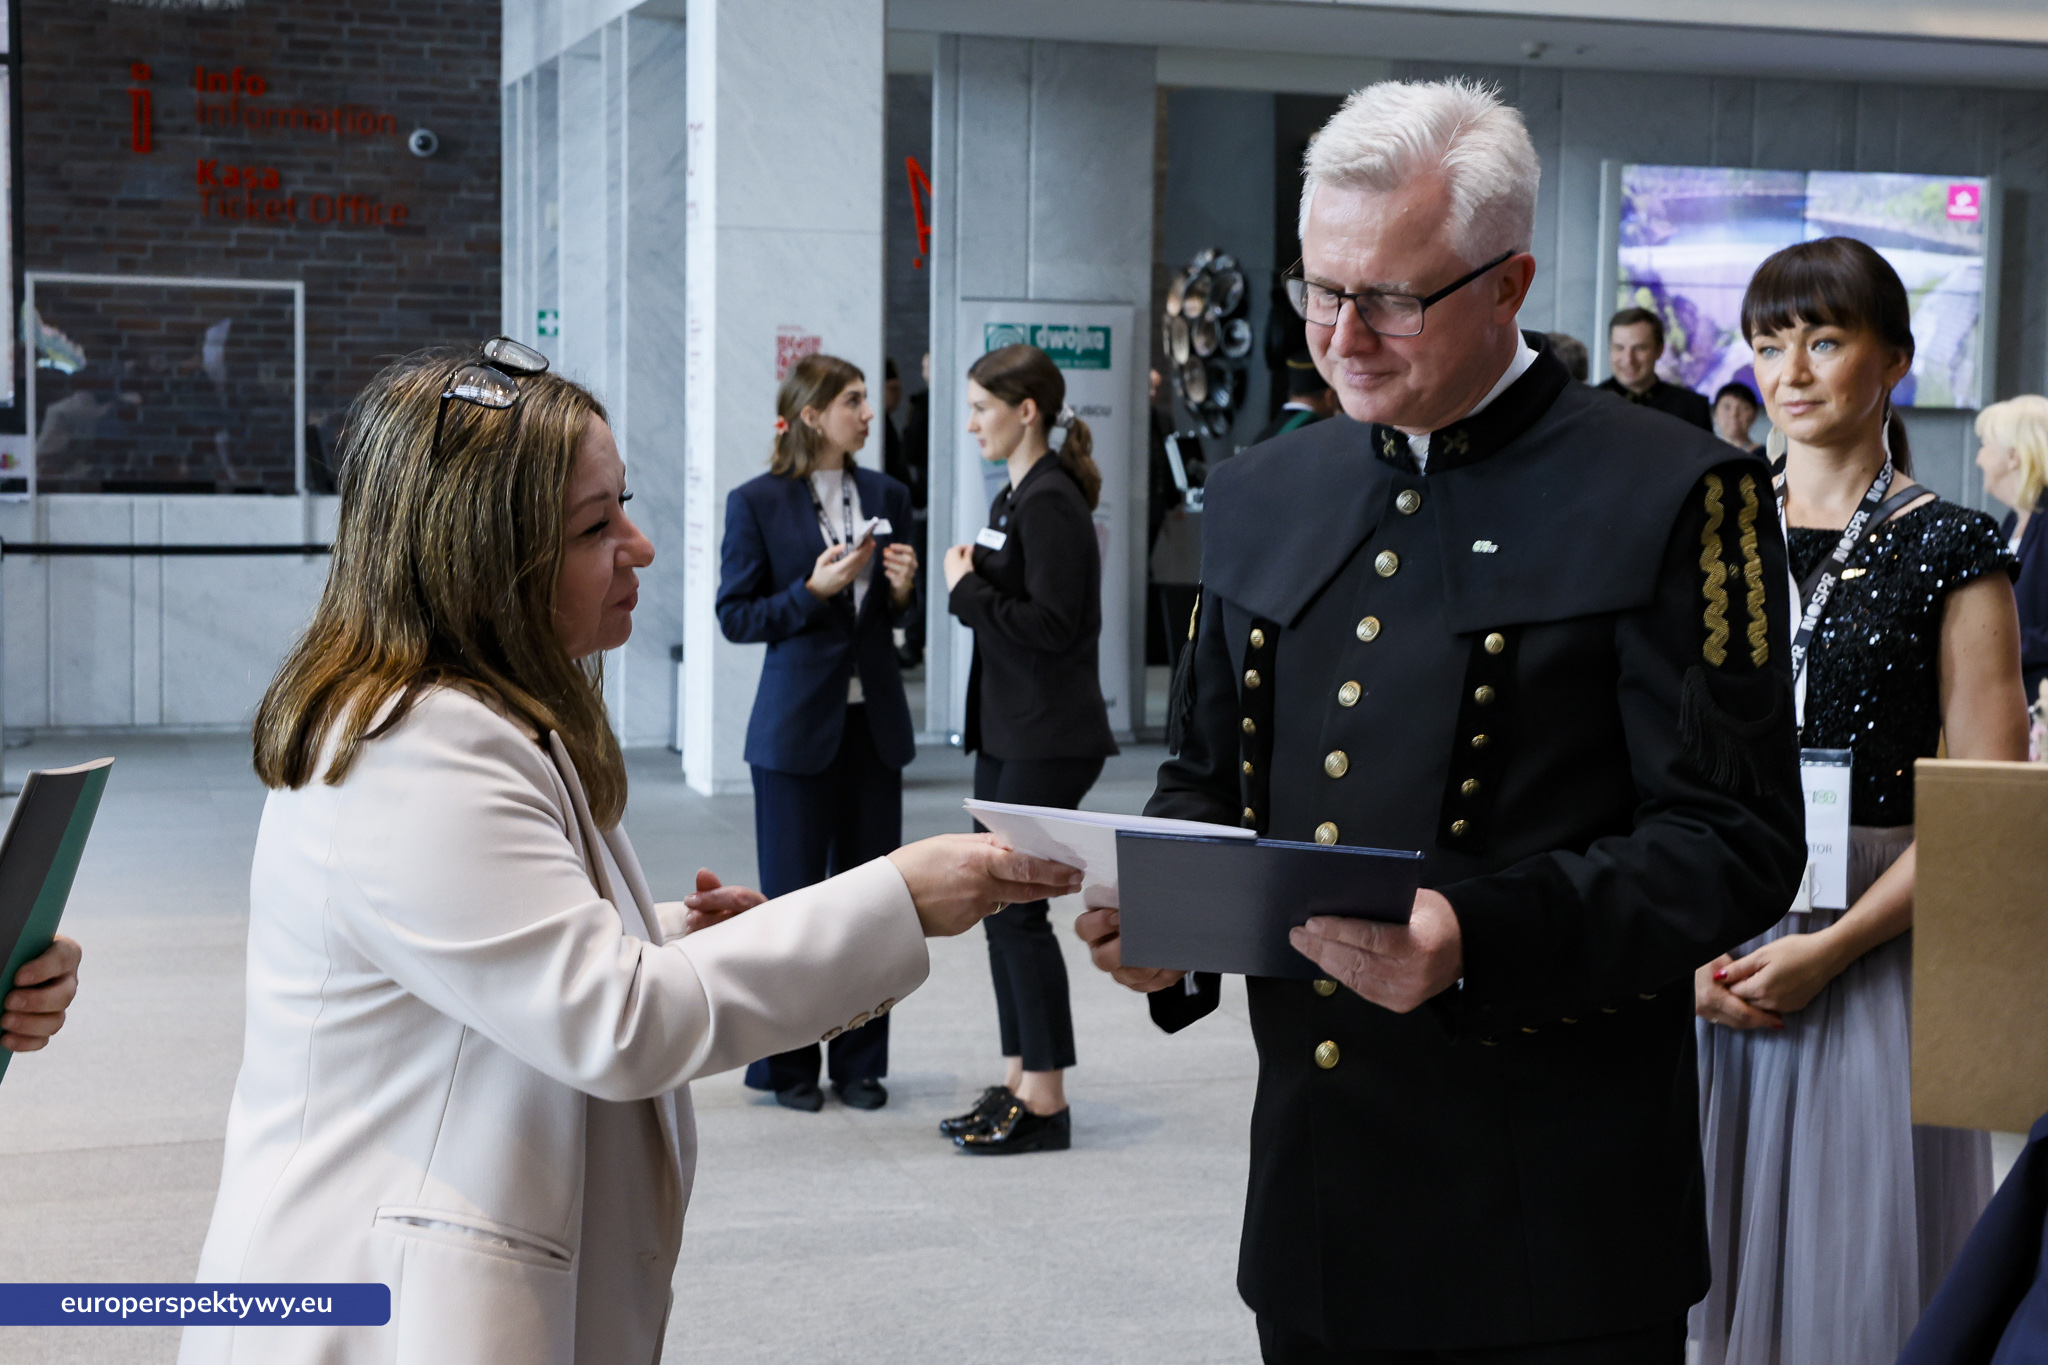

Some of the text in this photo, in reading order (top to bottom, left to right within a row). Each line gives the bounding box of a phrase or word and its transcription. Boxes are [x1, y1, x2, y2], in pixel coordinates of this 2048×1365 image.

[196, 65, 266, 96] Info
[196, 97, 396, 135] Information
[196, 158, 280, 190] Kasa
[199, 188, 408, 226] Ticket Office
[1832, 510, 1870, 563] NOSPR
[1800, 572, 1836, 631] NOSPR
